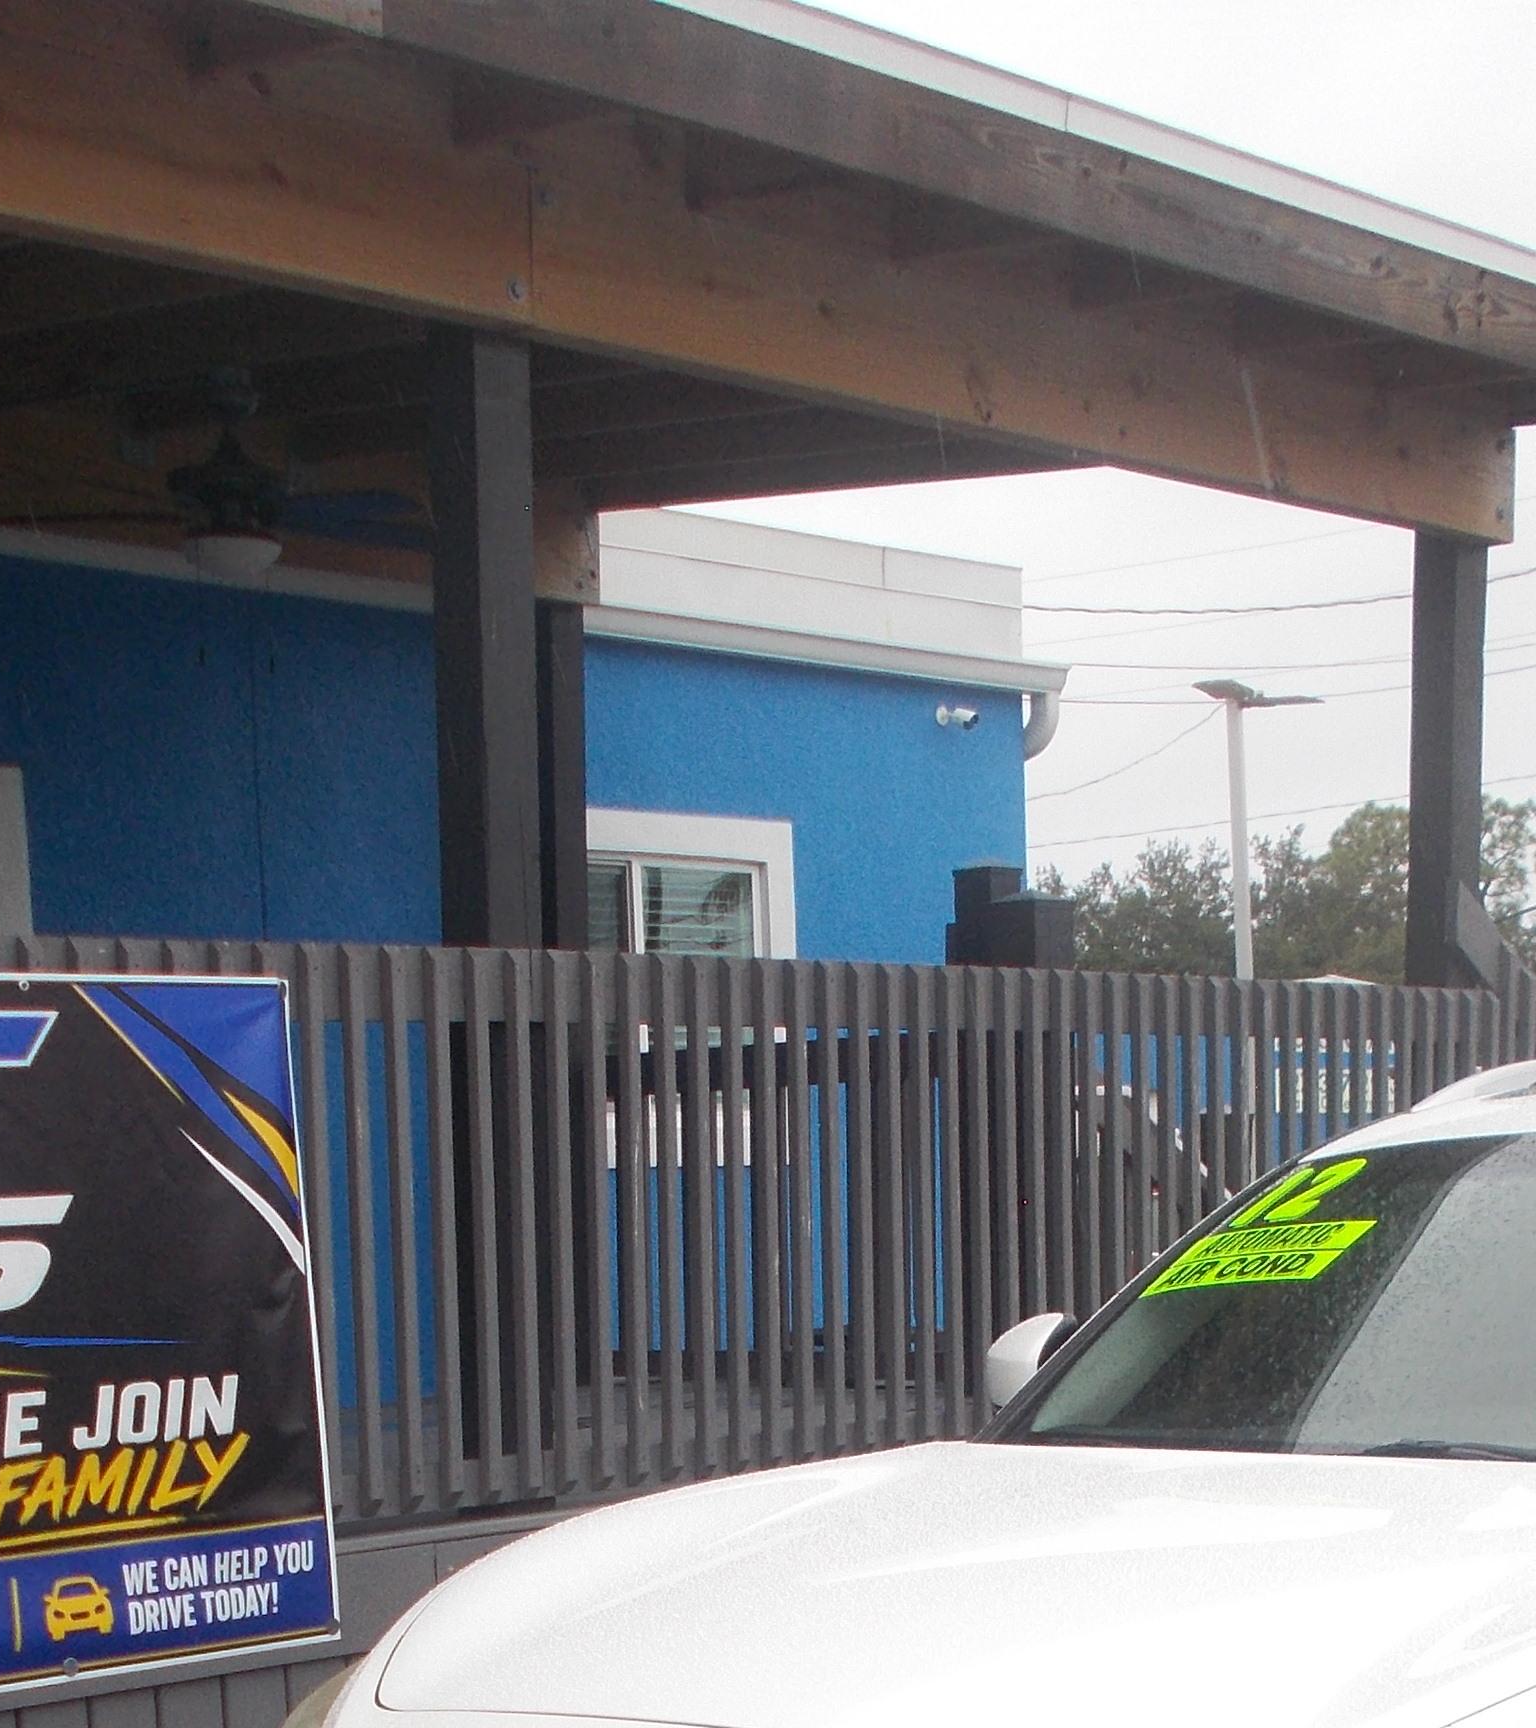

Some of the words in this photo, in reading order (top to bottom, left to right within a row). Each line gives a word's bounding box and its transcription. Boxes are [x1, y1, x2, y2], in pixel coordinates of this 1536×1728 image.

[1229, 1158, 1367, 1229] 12
[1195, 1223, 1345, 1259] AUTOMATIC
[1162, 1260, 1219, 1286] AIR
[1215, 1253, 1315, 1281] COND.
[72, 1374, 239, 1451] JOIN
[122, 1562, 160, 1597] WE
[163, 1554, 210, 1592] CAN
[214, 1547, 269, 1586] HELP
[275, 1540, 314, 1577] YOU
[129, 1594, 198, 1636] DRIVE
[203, 1581, 279, 1624] TODAY!
